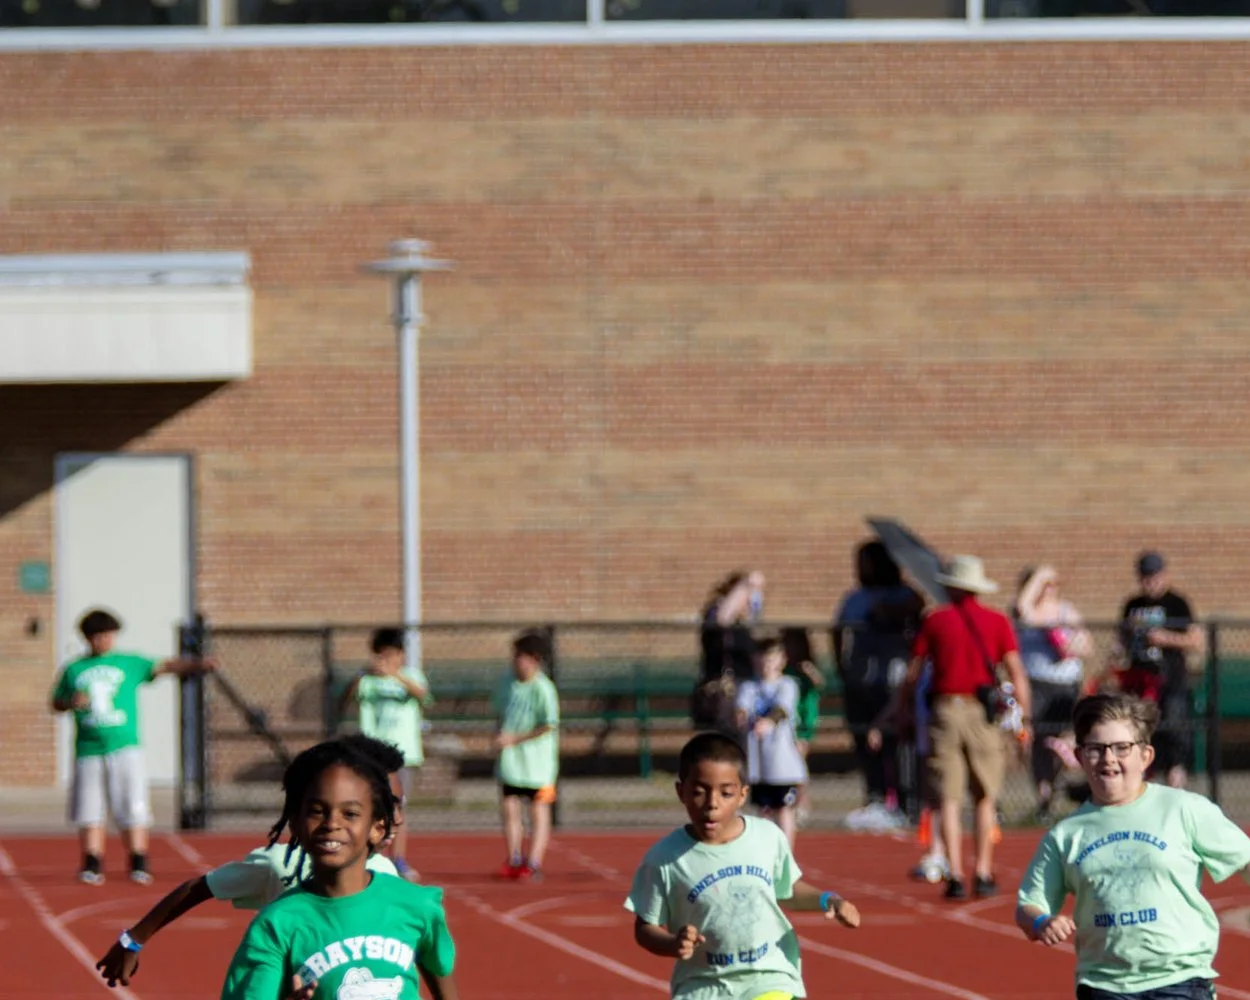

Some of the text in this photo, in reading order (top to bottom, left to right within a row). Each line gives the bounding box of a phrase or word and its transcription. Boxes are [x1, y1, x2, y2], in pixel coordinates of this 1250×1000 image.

[1133, 830, 1168, 851] HILLS
[1120, 907, 1157, 926] CLUB
[738, 942, 769, 963] CLUB
